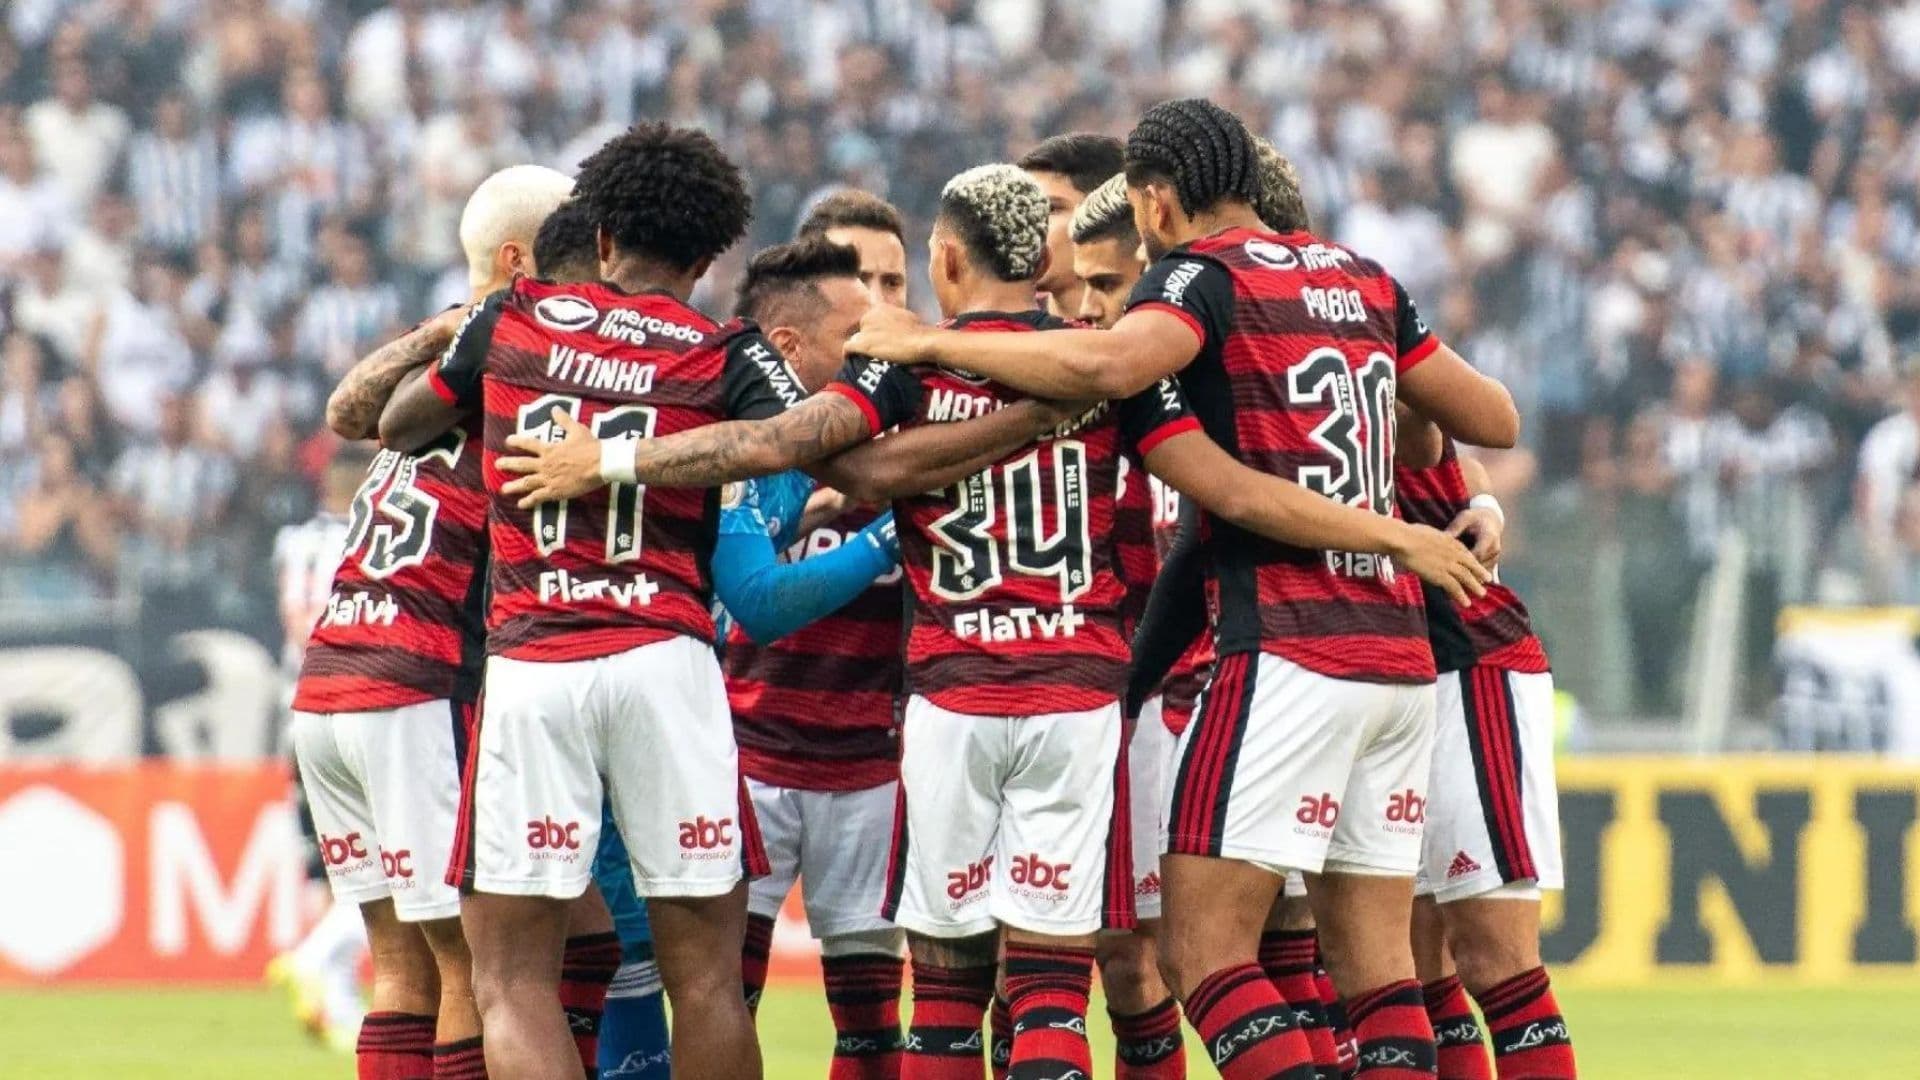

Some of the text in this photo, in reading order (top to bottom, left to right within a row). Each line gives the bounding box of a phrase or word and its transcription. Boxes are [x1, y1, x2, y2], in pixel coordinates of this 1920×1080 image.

[1162, 261, 1204, 306] HAVAN
[1301, 286, 1367, 322] PABLO
[597, 322, 646, 346] livre
[606, 308, 704, 343] mercado
[548, 344, 657, 395] VITINHO
[743, 342, 806, 409] HAVAN
[1288, 347, 1396, 518] 30
[516, 394, 658, 564] 11
[929, 440, 1092, 603] 34
[1296, 792, 1340, 828] ab
[1386, 789, 1426, 823] ab
[527, 814, 580, 850] abc
[678, 815, 733, 850] abc
[148, 799, 304, 959] M
[1010, 852, 1071, 891] abc
